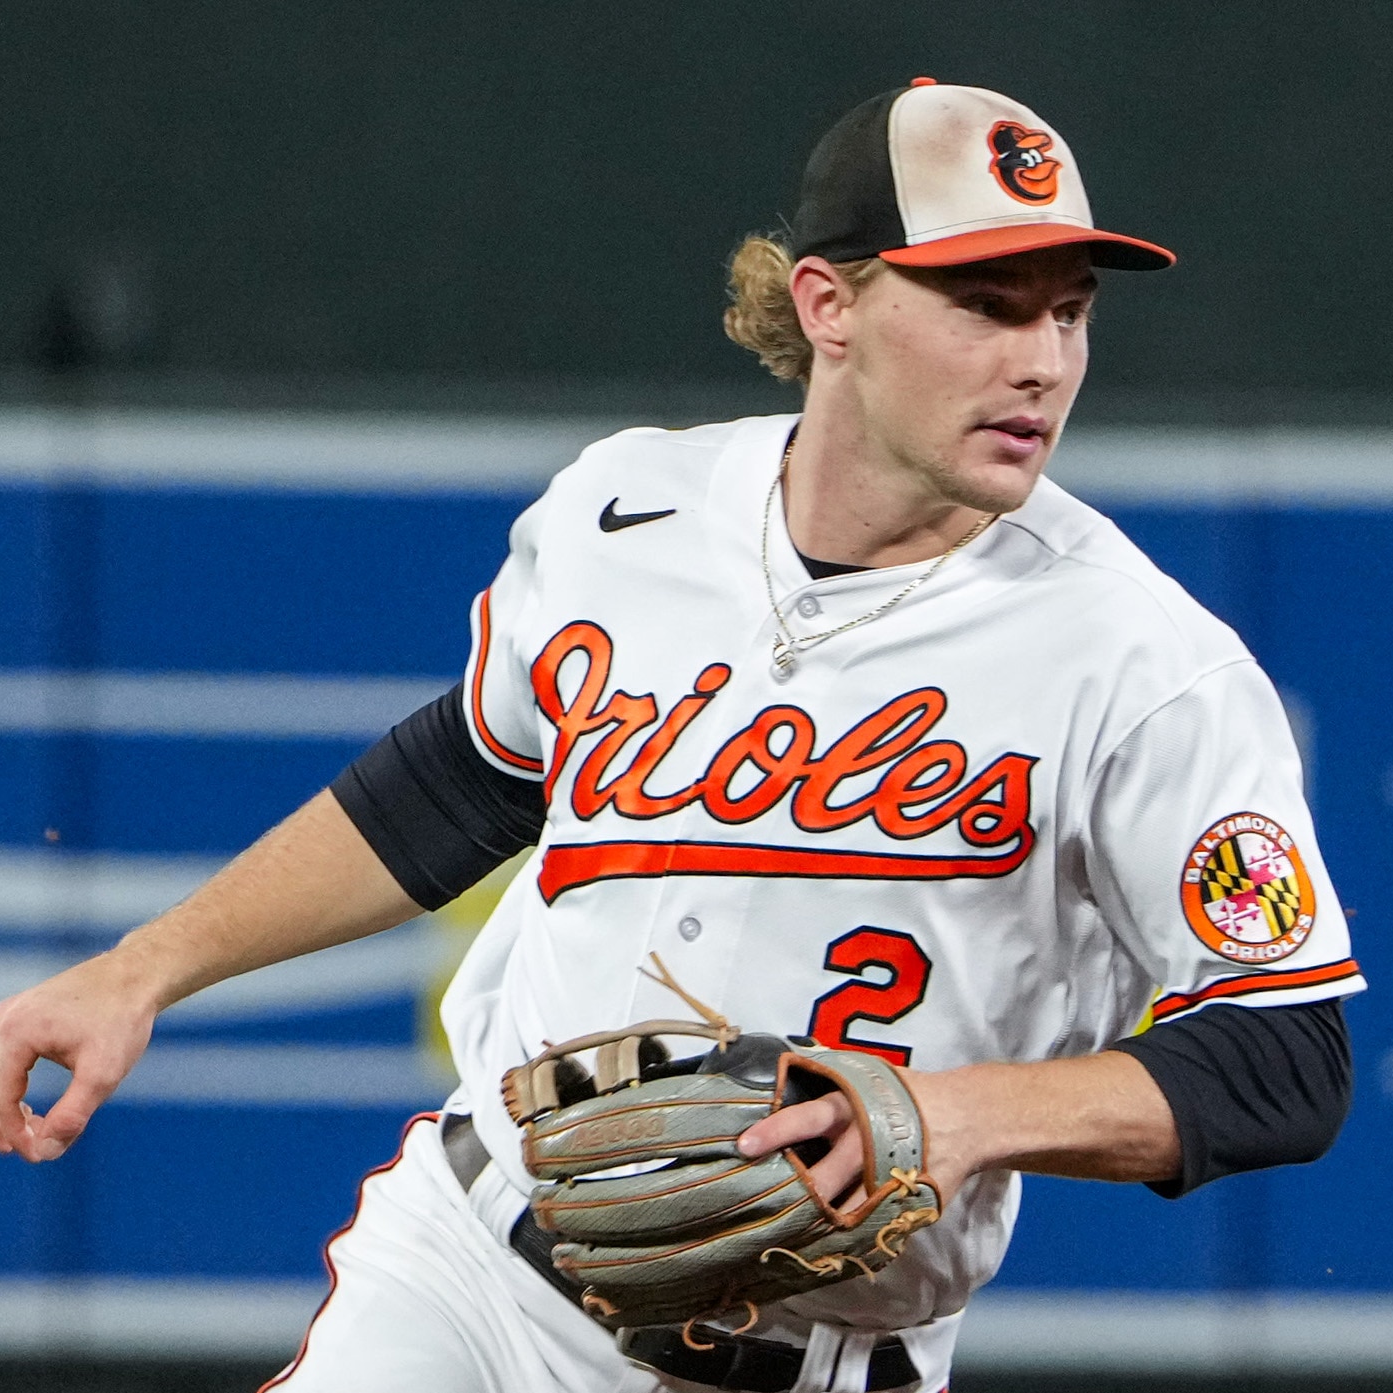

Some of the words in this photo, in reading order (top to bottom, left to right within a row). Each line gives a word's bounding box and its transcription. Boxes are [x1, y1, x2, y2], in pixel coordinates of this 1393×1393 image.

[531, 620, 1040, 848] Orioles
[1184, 815, 1296, 884] BALTIMORE
[1219, 913, 1313, 959] ORIOLES
[806, 925, 932, 1068] 2
